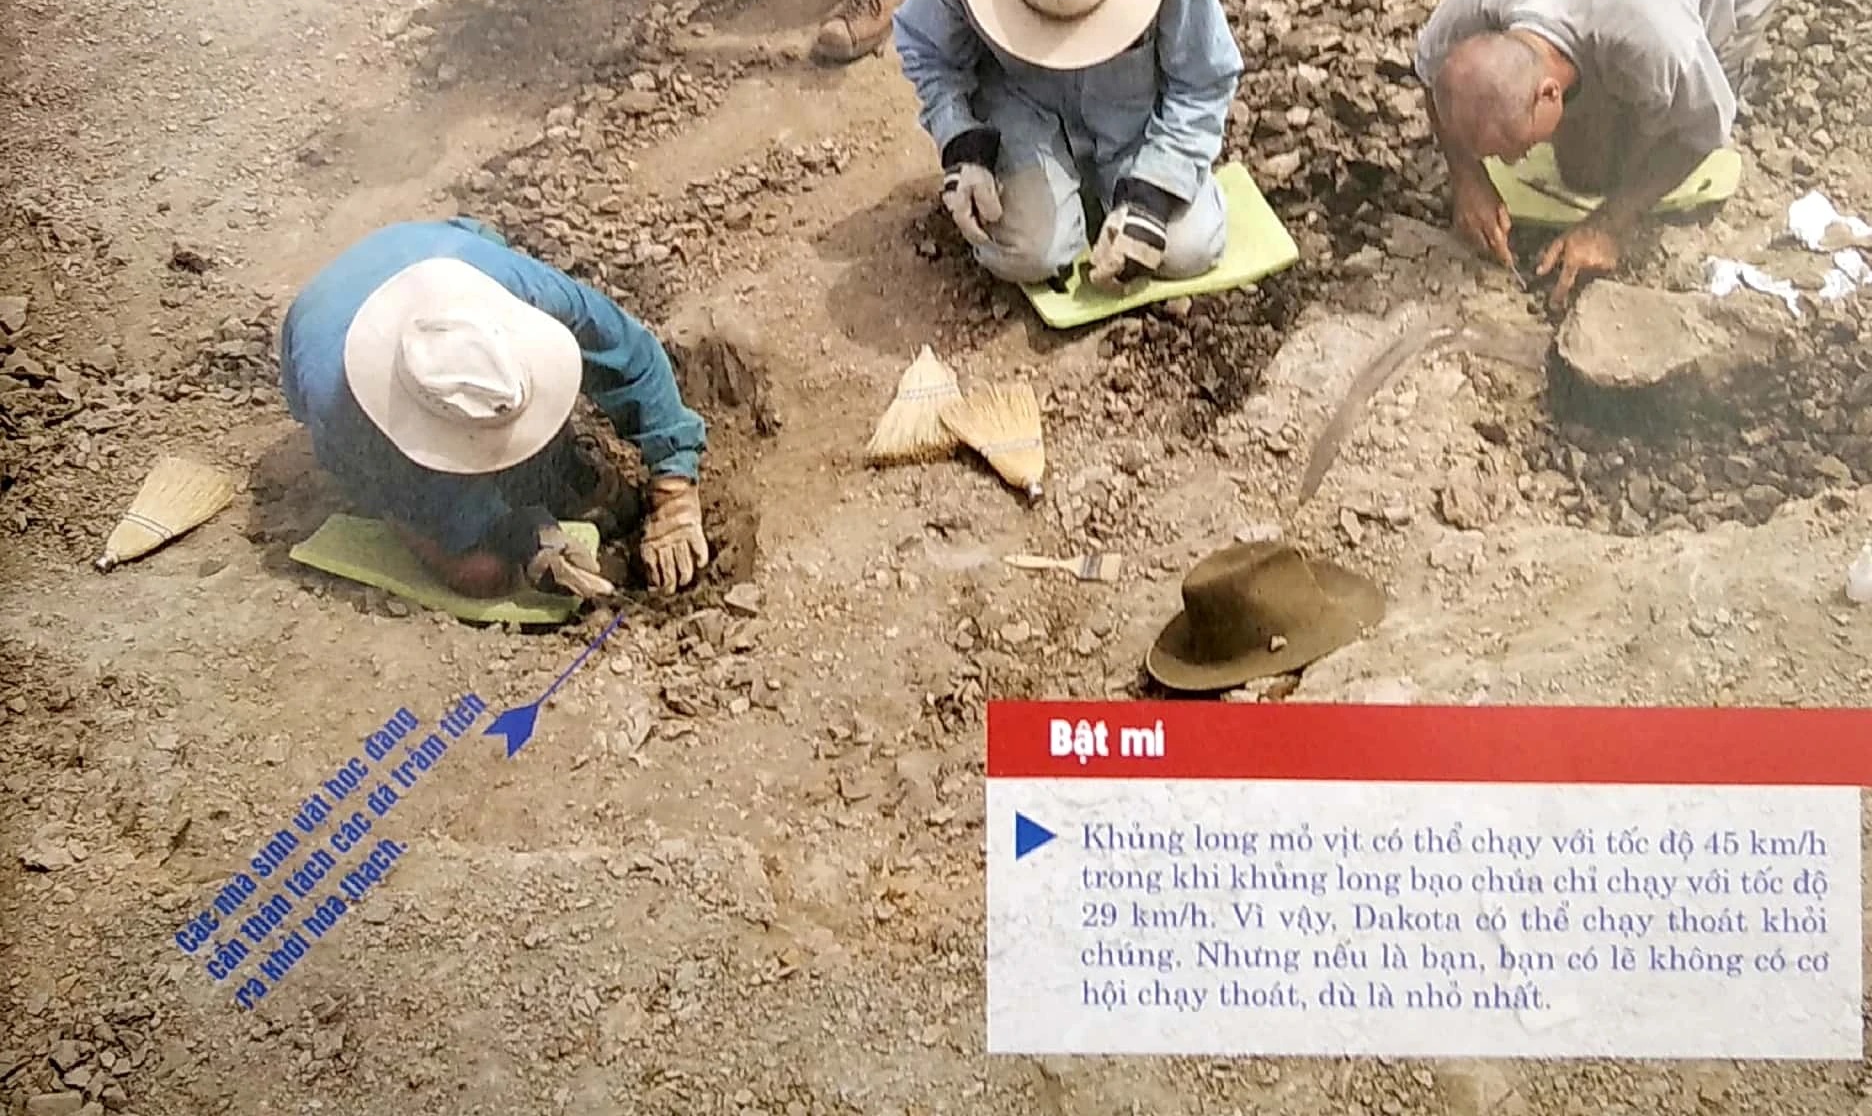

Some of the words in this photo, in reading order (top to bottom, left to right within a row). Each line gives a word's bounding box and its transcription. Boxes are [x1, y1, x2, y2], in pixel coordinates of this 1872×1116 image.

[1050, 718, 1109, 764] Bật
[1120, 719, 1165, 757] mí
[174, 908, 220, 955] Các
[213, 871, 257, 917] nhà
[251, 828, 299, 879] sinh
[293, 792, 333, 835] vật
[324, 755, 369, 802] học
[364, 706, 420, 763] đang
[206, 940, 249, 981] cẩn
[240, 893, 293, 943] thận
[284, 848, 336, 899] tách
[330, 811, 372, 854] các
[367, 781, 400, 817] đá
[390, 733, 448, 789] trầm
[440, 692, 488, 739] tích
[1081, 819, 1183, 855] Khủng
[1196, 822, 1258, 855] long
[1270, 822, 1312, 851] mỏ
[1323, 826, 1360, 858] vịt
[1372, 827, 1401, 851] có
[1414, 822, 1463, 855] thể
[1472, 827, 1542, 862] chạy
[1553, 828, 1594, 855] với
[1606, 826, 1649, 855] tốc
[1659, 829, 1694, 862] độ
[1705, 831, 1738, 856] 45
[1750, 829, 1826, 857] km/h
[1082, 867, 1162, 894] trong
[1173, 864, 1219, 890] khi
[1230, 860, 1326, 895] khủng
[1337, 864, 1400, 896] long
[1411, 866, 1463, 896] bạo
[1472, 867, 1543, 893] chúa
[1553, 865, 1597, 893] chỉ
[1606, 868, 1677, 901] chạy
[1688, 868, 1730, 895] với
[1741, 868, 1783, 895] tốc
[1792, 870, 1828, 902] độ
[235, 977, 268, 1011] ra
[260, 930, 311, 983] khỏi
[339, 836, 409, 902] thạch.
[1081, 902, 1117, 928] 29
[1132, 902, 1216, 930] km/h.
[1233, 903, 1264, 929] Vì
[1279, 905, 1337, 936] vậy,
[1355, 903, 1460, 932] Dakota
[1475, 908, 1506, 933] có
[1521, 899, 1570, 933] thể
[1583, 905, 1654, 938] chạy
[1668, 907, 1747, 934] thoát
[1761, 906, 1827, 934] khỏi
[1081, 941, 1181, 973] chúng.
[1196, 941, 1300, 972] Nhưng
[1313, 937, 1367, 969] nếu
[1380, 944, 1408, 969] là
[1422, 944, 1486, 977] bạn,
[1500, 944, 1553, 977] bạn
[1567, 944, 1598, 971] có
[1611, 944, 1636, 972] lẽ
[1649, 944, 1743, 977] không
[1754, 947, 1785, 973] có
[1797, 949, 1829, 973] cơ
[1082, 980, 1127, 1012] hội
[1137, 982, 1207, 1012] chạy
[1219, 981, 1307, 1010] thoát,
[1318, 982, 1357, 1008] dù
[1368, 982, 1393, 1008] là
[1407, 980, 1461, 1010] nhỏ
[1473, 977, 1552, 1011] nhất.
